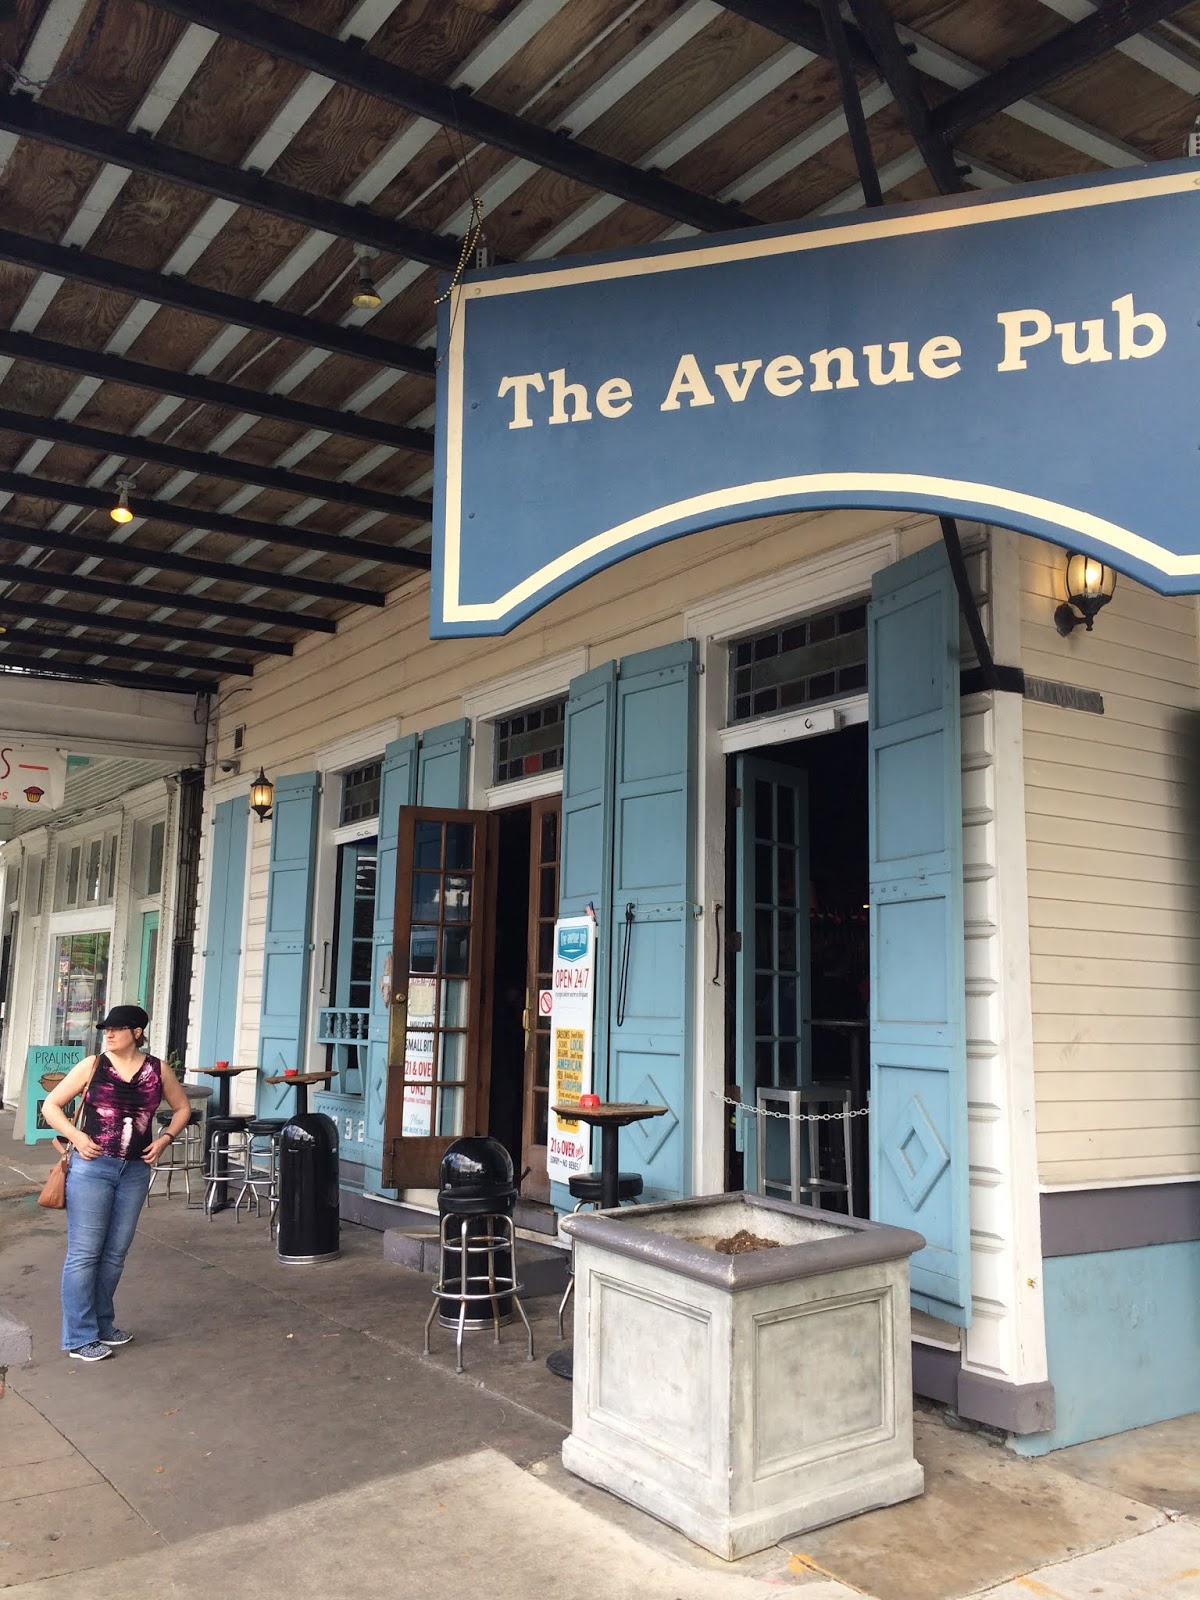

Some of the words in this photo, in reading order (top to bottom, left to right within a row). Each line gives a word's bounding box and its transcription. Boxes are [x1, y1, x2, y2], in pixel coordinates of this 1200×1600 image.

[498, 368, 632, 429] The
[660, 336, 962, 411] Avenue
[996, 294, 1166, 372] Pub
[556, 969, 573, 989] OPEN
[406, 1038, 422, 1052] SMALL
[424, 1039, 434, 1053] BIT
[570, 1040, 584, 1051] LOCAL
[36, 1052, 80, 1064] PRALINES
[558, 1058, 582, 1071] AMERICAN
[404, 1060, 412, 1076] 21
[412, 1062, 418, 1076] &
[418, 1061, 432, 1077] OVE
[551, 1137, 556, 1153] 21
[557, 1142, 561, 1154] &
[562, 1140, 575, 1158] OVER
